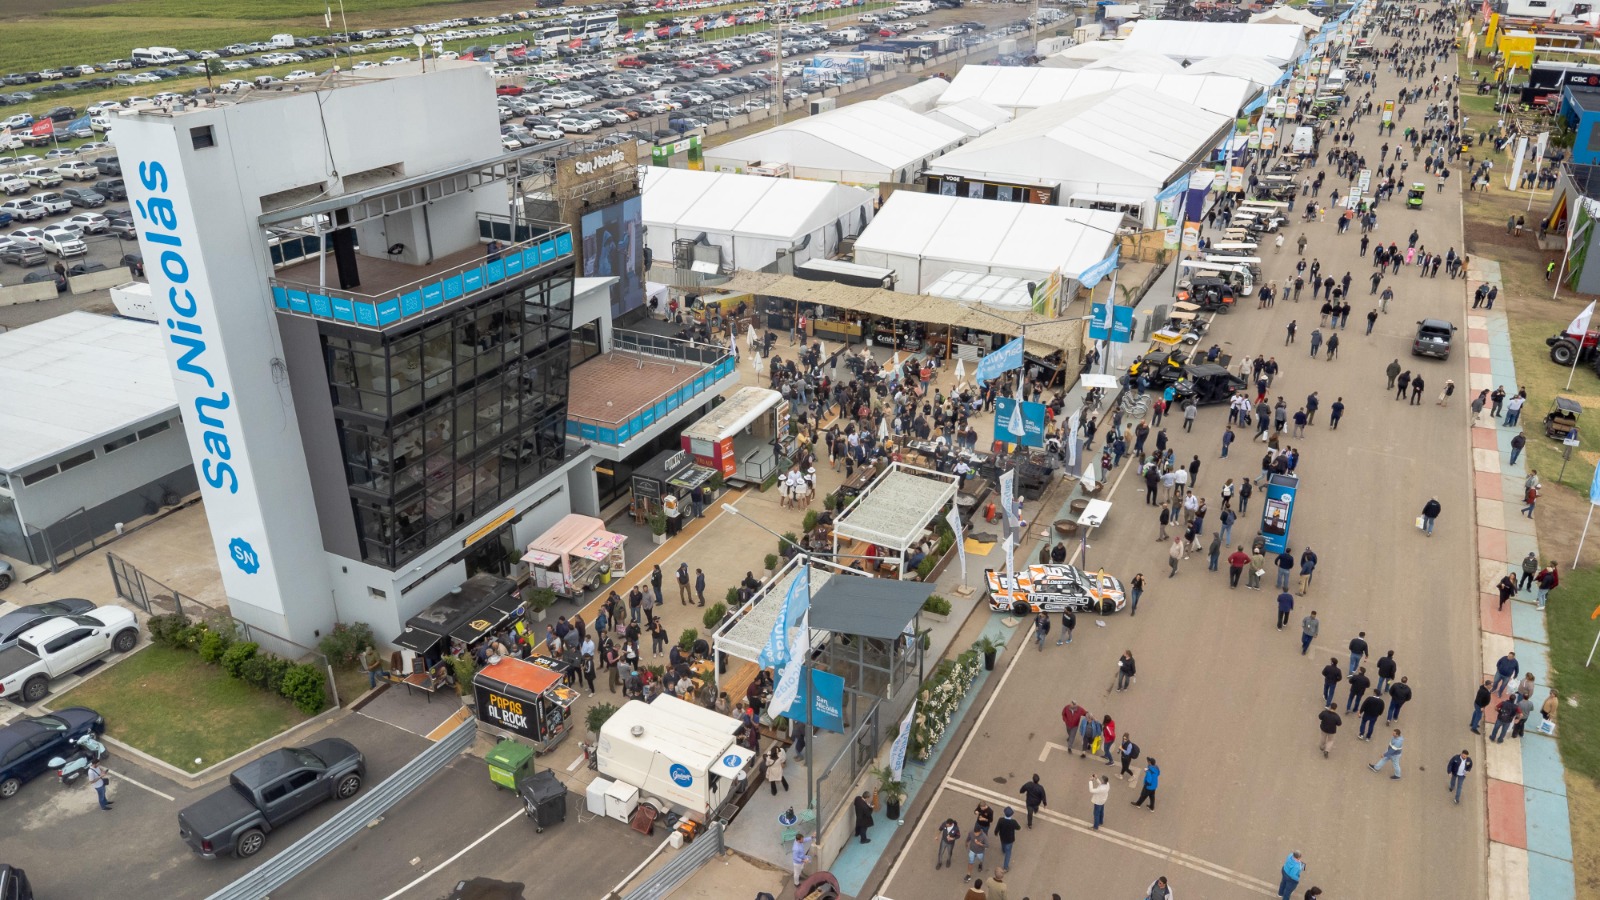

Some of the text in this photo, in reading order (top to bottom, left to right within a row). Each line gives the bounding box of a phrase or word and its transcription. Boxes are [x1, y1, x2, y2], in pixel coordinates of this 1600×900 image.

[575, 149, 625, 175] San Nicolás
[136, 160, 239, 495] San Nicolás
[234, 545, 255, 566] SN
[489, 693, 523, 715] PAPAS
[815, 695, 829, 707] San
[815, 702, 839, 715] Nicolás
[488, 705, 502, 720] AL
[502, 710, 528, 729] ROCK
